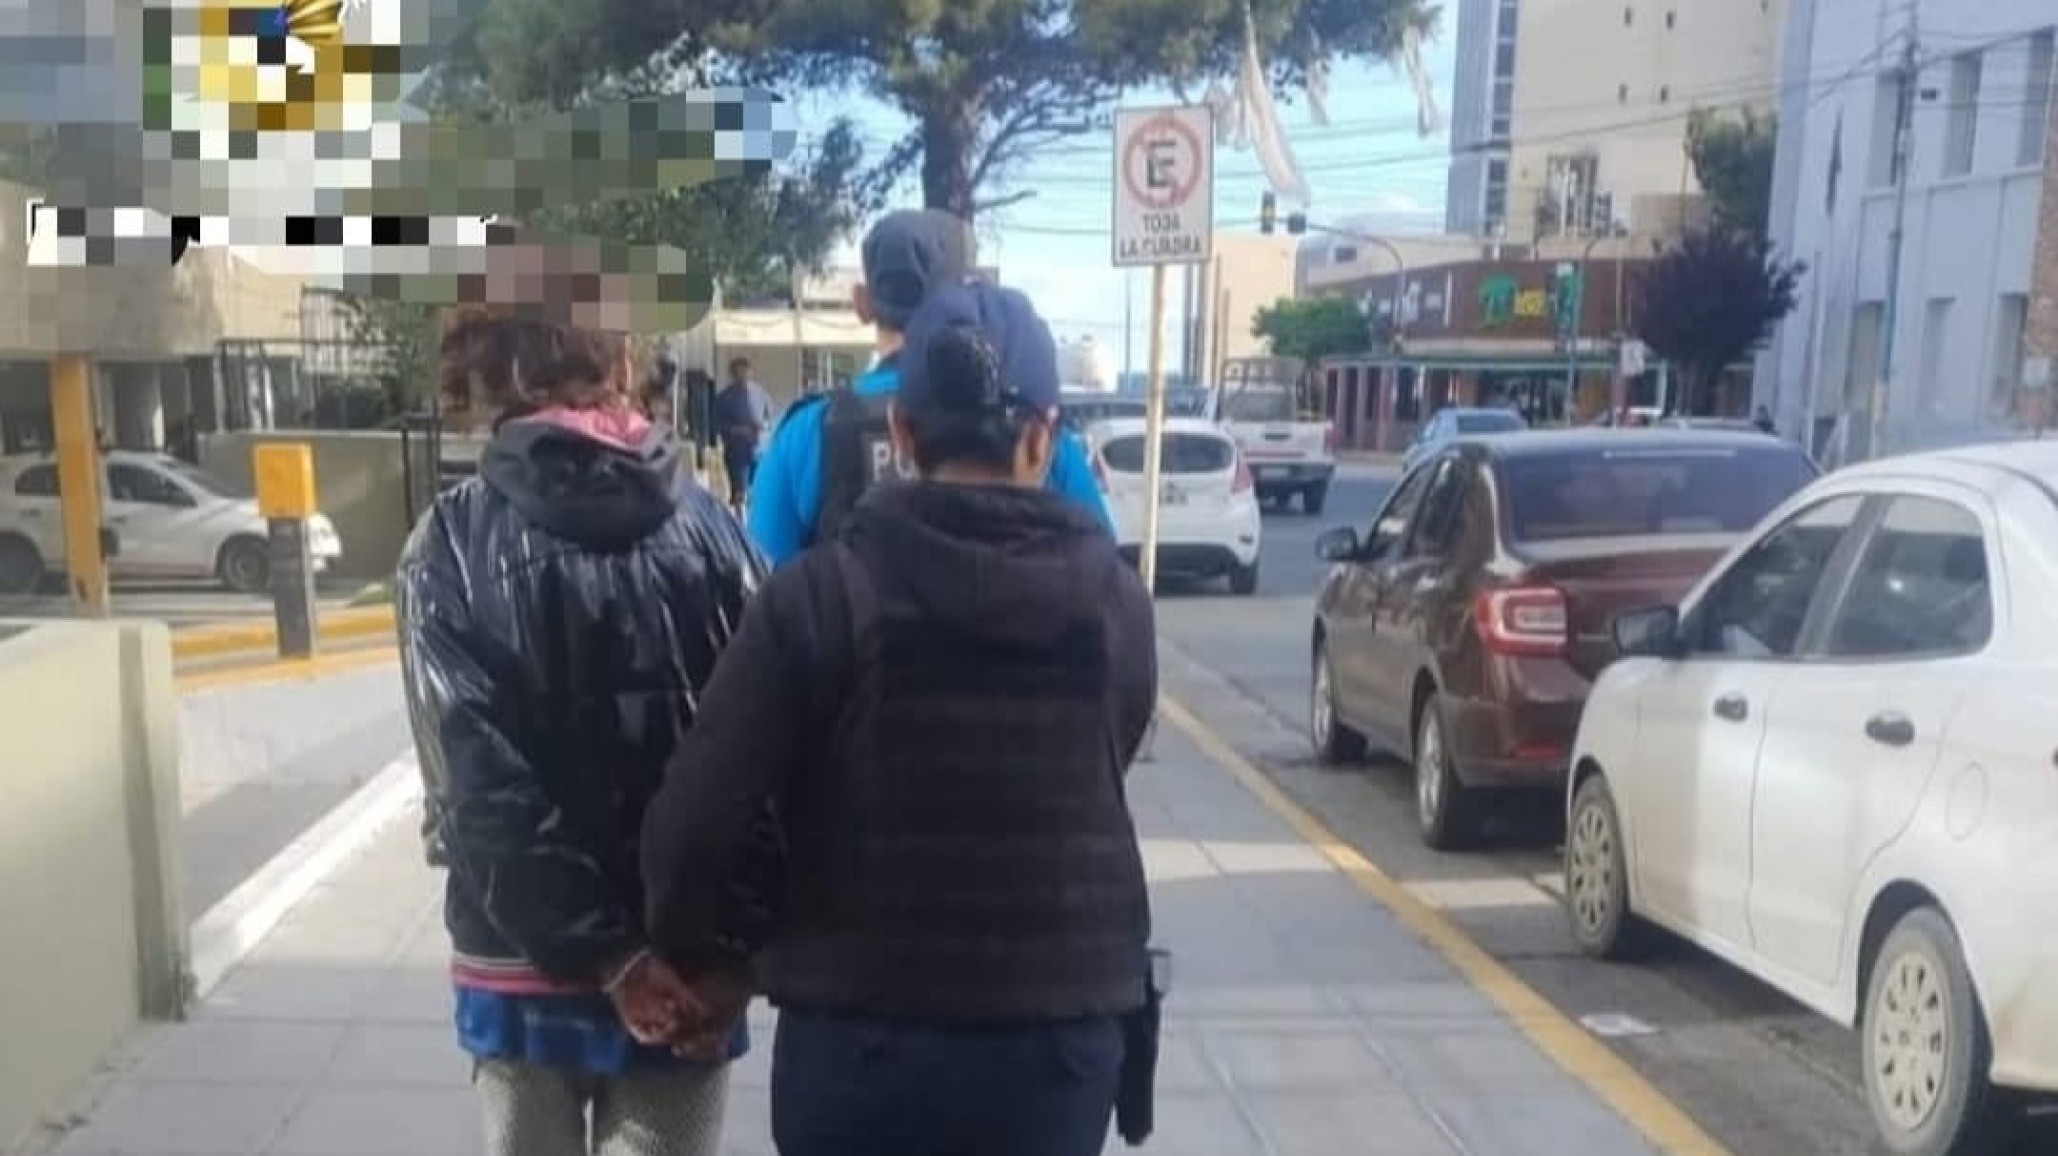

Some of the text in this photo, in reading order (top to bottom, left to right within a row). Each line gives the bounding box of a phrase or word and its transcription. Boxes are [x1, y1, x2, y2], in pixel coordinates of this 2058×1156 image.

[1147, 140, 1177, 188] E
[1119, 235, 1201, 258] LA CUADRA
